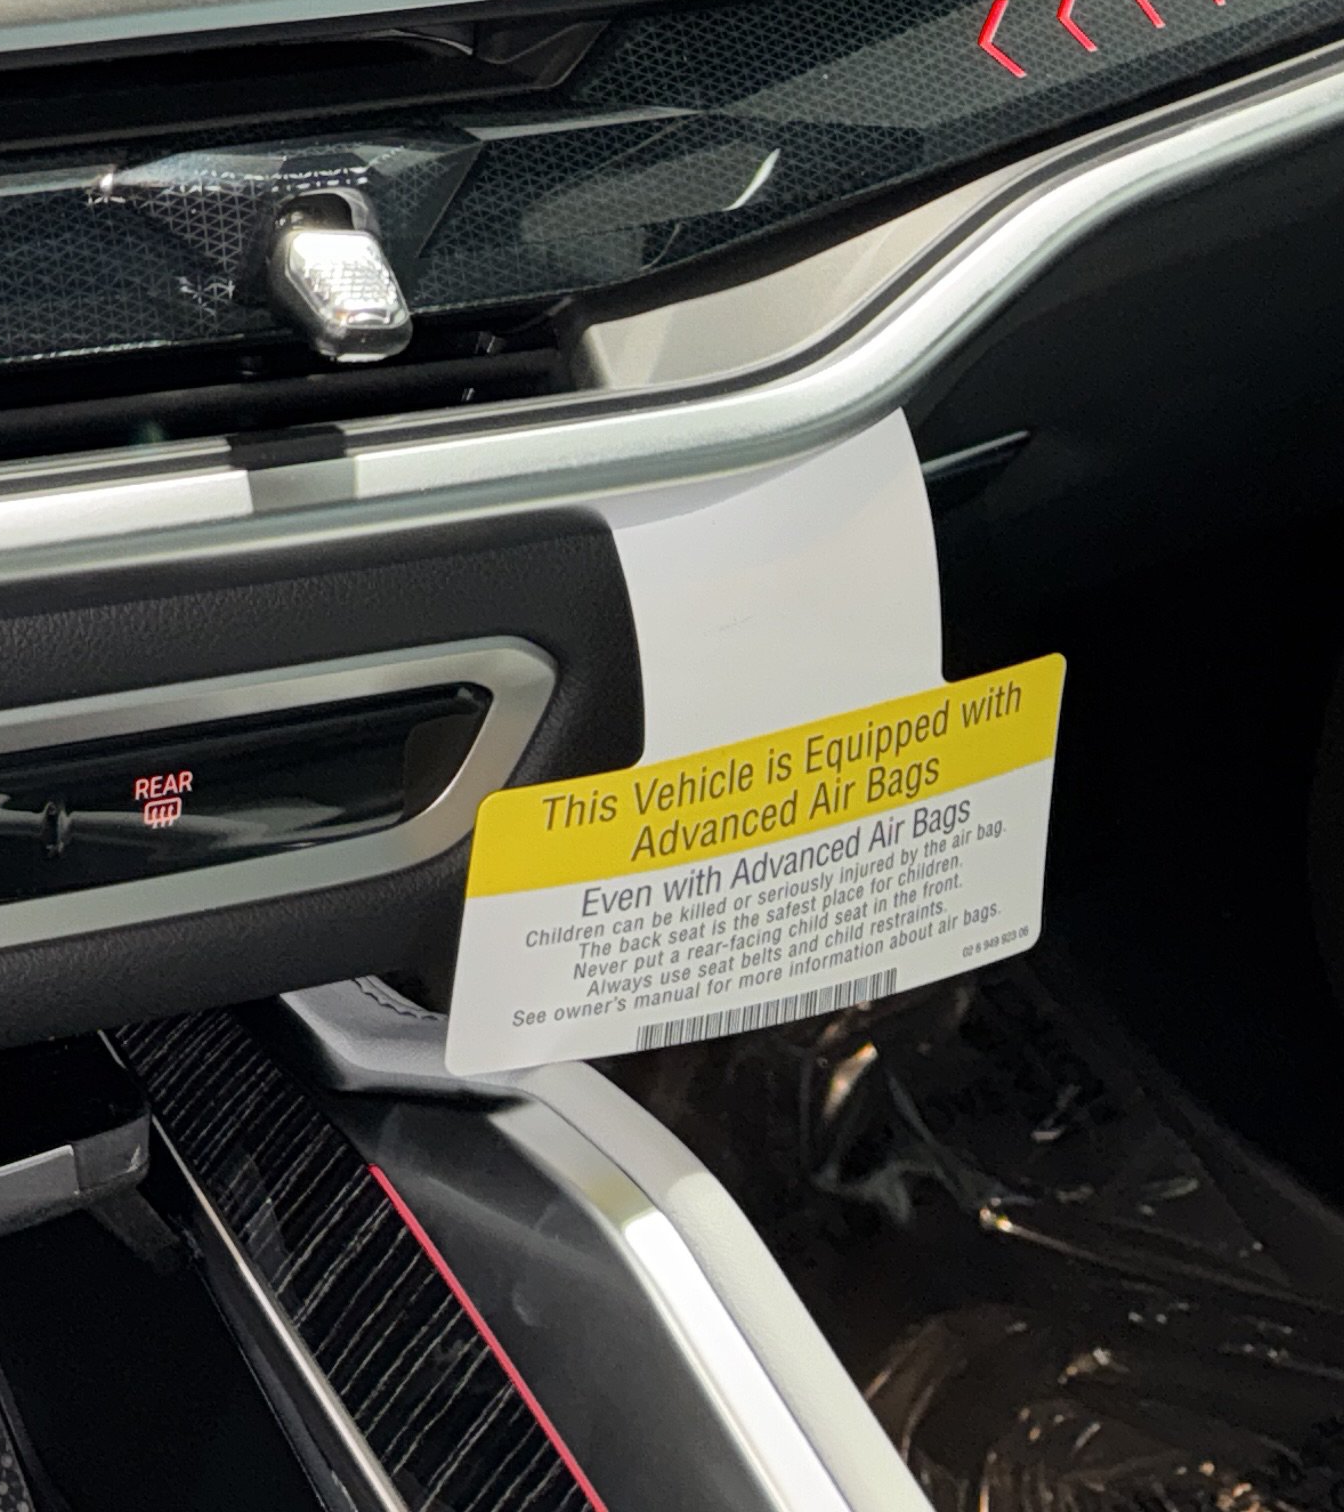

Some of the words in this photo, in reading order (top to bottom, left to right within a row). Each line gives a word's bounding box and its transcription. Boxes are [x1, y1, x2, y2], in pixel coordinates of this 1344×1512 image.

[134, 771, 193, 801] REAR
[542, 790, 618, 831] This
[634, 759, 754, 816] Vehicle
[767, 748, 793, 785] is
[806, 699, 950, 775] Equipped
[962, 681, 1022, 729] with
[631, 790, 798, 862] Advanced
[809, 777, 856, 821] Air
[867, 758, 940, 803] Bags
[525, 922, 605, 948] Children
[612, 916, 644, 935] can
[652, 911, 672, 928] be
[679, 897, 727, 923] killed
[733, 894, 753, 910] or
[757, 872, 834, 906] seriously
[839, 852, 895, 885] injured
[900, 846, 919, 868] by
[923, 837, 947, 856] the
[951, 828, 973, 848] air
[976, 819, 1007, 838] bag.
[578, 941, 612, 960] The
[619, 931, 662, 953] back
[667, 921, 705, 945] seat
[712, 918, 727, 936] is
[733, 911, 760, 931] the
[766, 896, 817, 923] safest
[822, 884, 864, 912] place
[870, 876, 894, 894] for
[898, 854, 963, 886] children.
[581, 884, 652, 917] Even
[663, 865, 722, 903] with
[730, 826, 861, 889] Advanced
[868, 816, 906, 852] Air
[912, 800, 971, 839] Bags
[512, 1006, 547, 1028] See
[553, 996, 627, 1022] owner's
[633, 981, 701, 1010] manual
[706, 975, 732, 996] for
[738, 966, 783, 990] more
[789, 940, 884, 978] information
[889, 923, 933, 950] about
[937, 914, 959, 936] air
[963, 901, 1001, 927] bags.
[573, 958, 629, 980] Never
[634, 951, 664, 973] put
[670, 949, 680, 963] a
[687, 926, 782, 961] rear-facing
[788, 911, 829, 937] child
[834, 902, 868, 926] seat
[873, 895, 888, 914] in
[893, 888, 917, 908] the
[922, 872, 962, 899] front.
[586, 971, 653, 997] Always
[661, 967, 691, 985] use
[697, 954, 736, 978] seat
[741, 945, 782, 970] belts
[788, 936, 818, 959] and
[824, 922, 864, 949] child
[869, 900, 947, 935] restraints.
